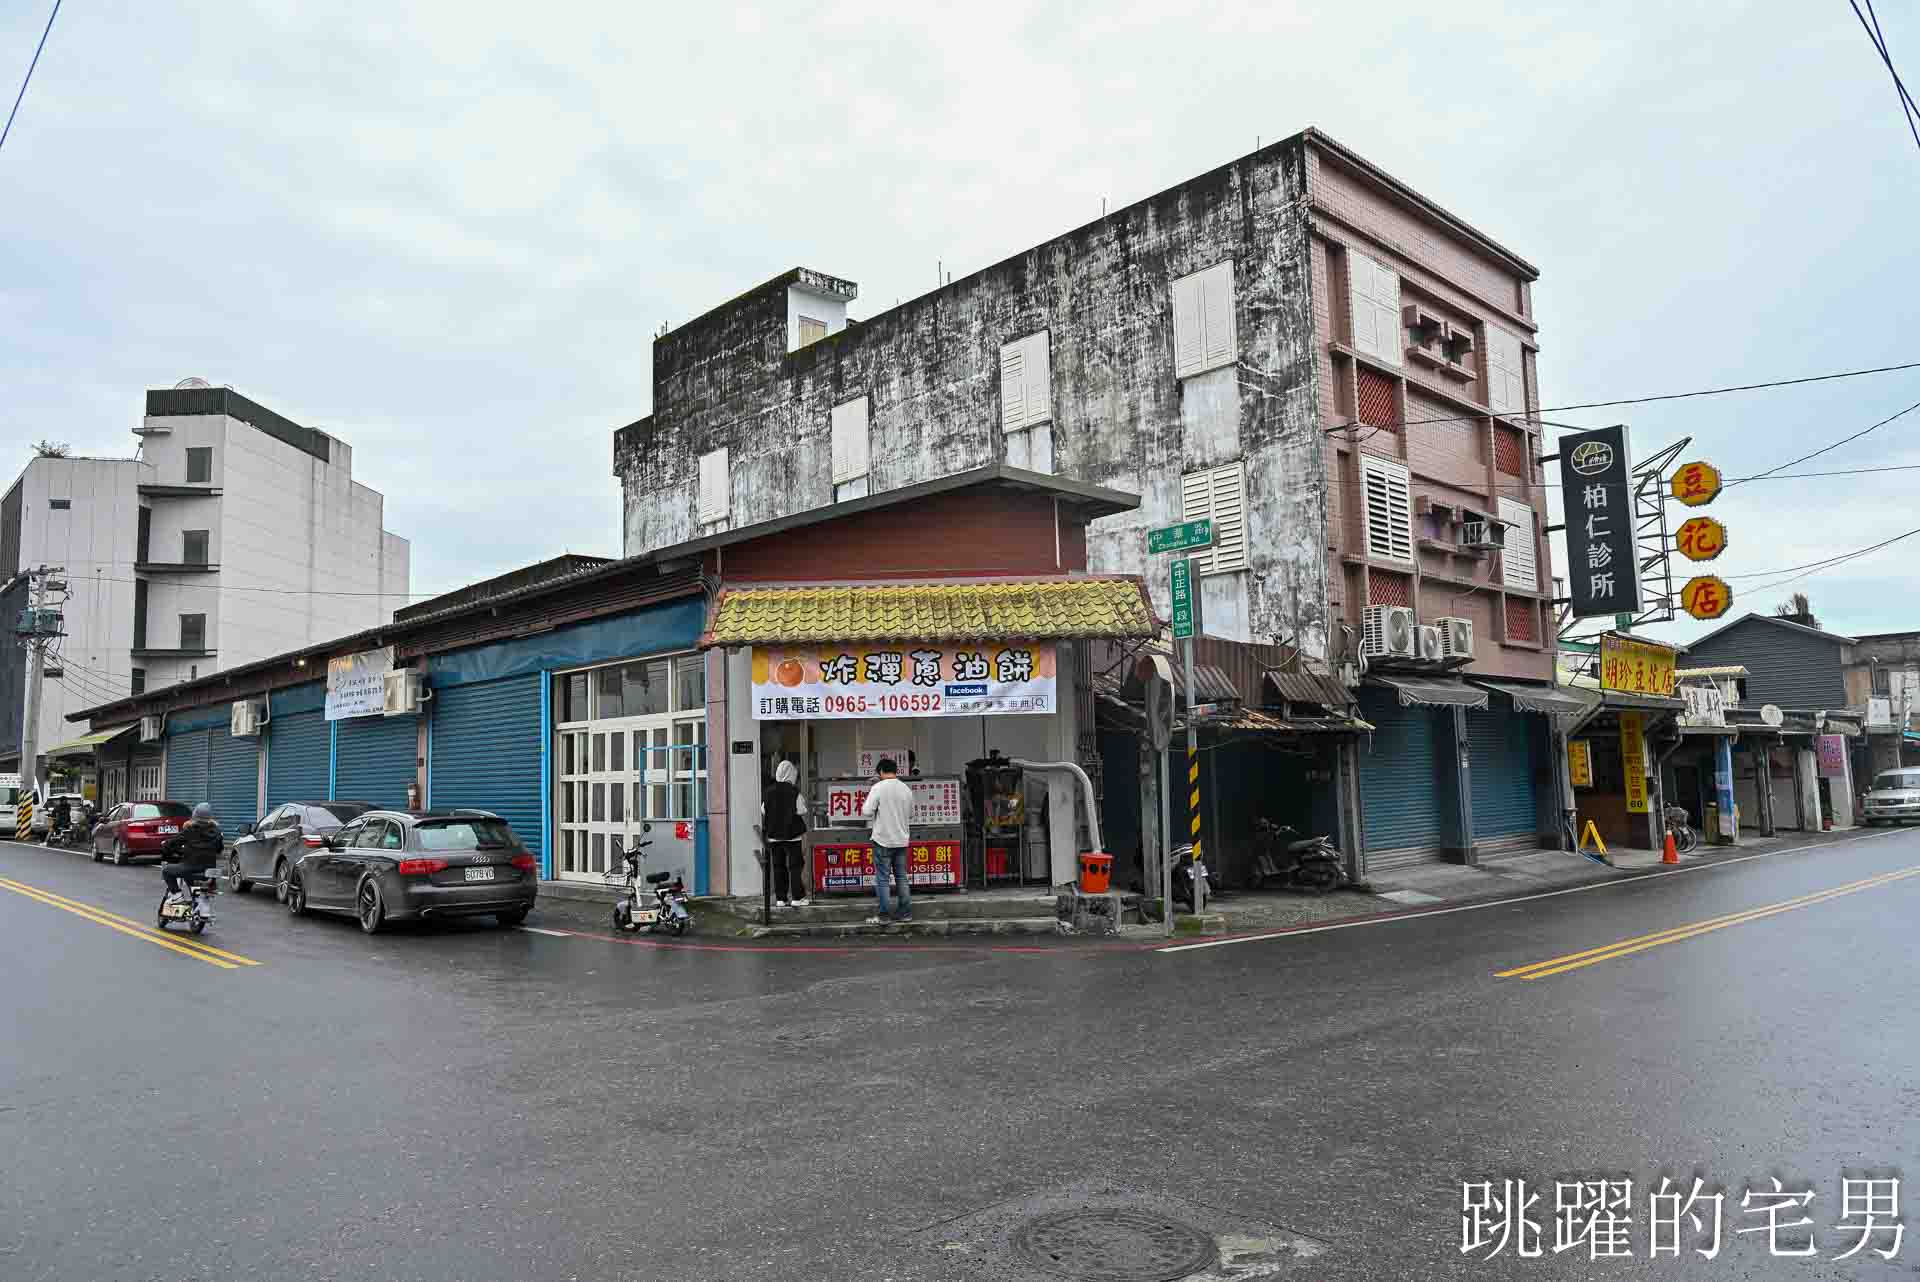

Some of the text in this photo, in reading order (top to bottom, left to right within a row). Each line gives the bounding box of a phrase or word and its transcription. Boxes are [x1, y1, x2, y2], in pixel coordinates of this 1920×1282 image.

[1583, 483, 1616, 599] 柏仁診所
[1681, 466, 1720, 615] 豆花店
[1174, 567, 1187, 621] 中正路一段
[820, 648, 1033, 687] 炸彈蔥油餅
[760, 694, 941, 714] 訂購電話 0965-106592
[949, 687, 984, 695] facebook
[844, 846, 952, 865] 炸油餅
